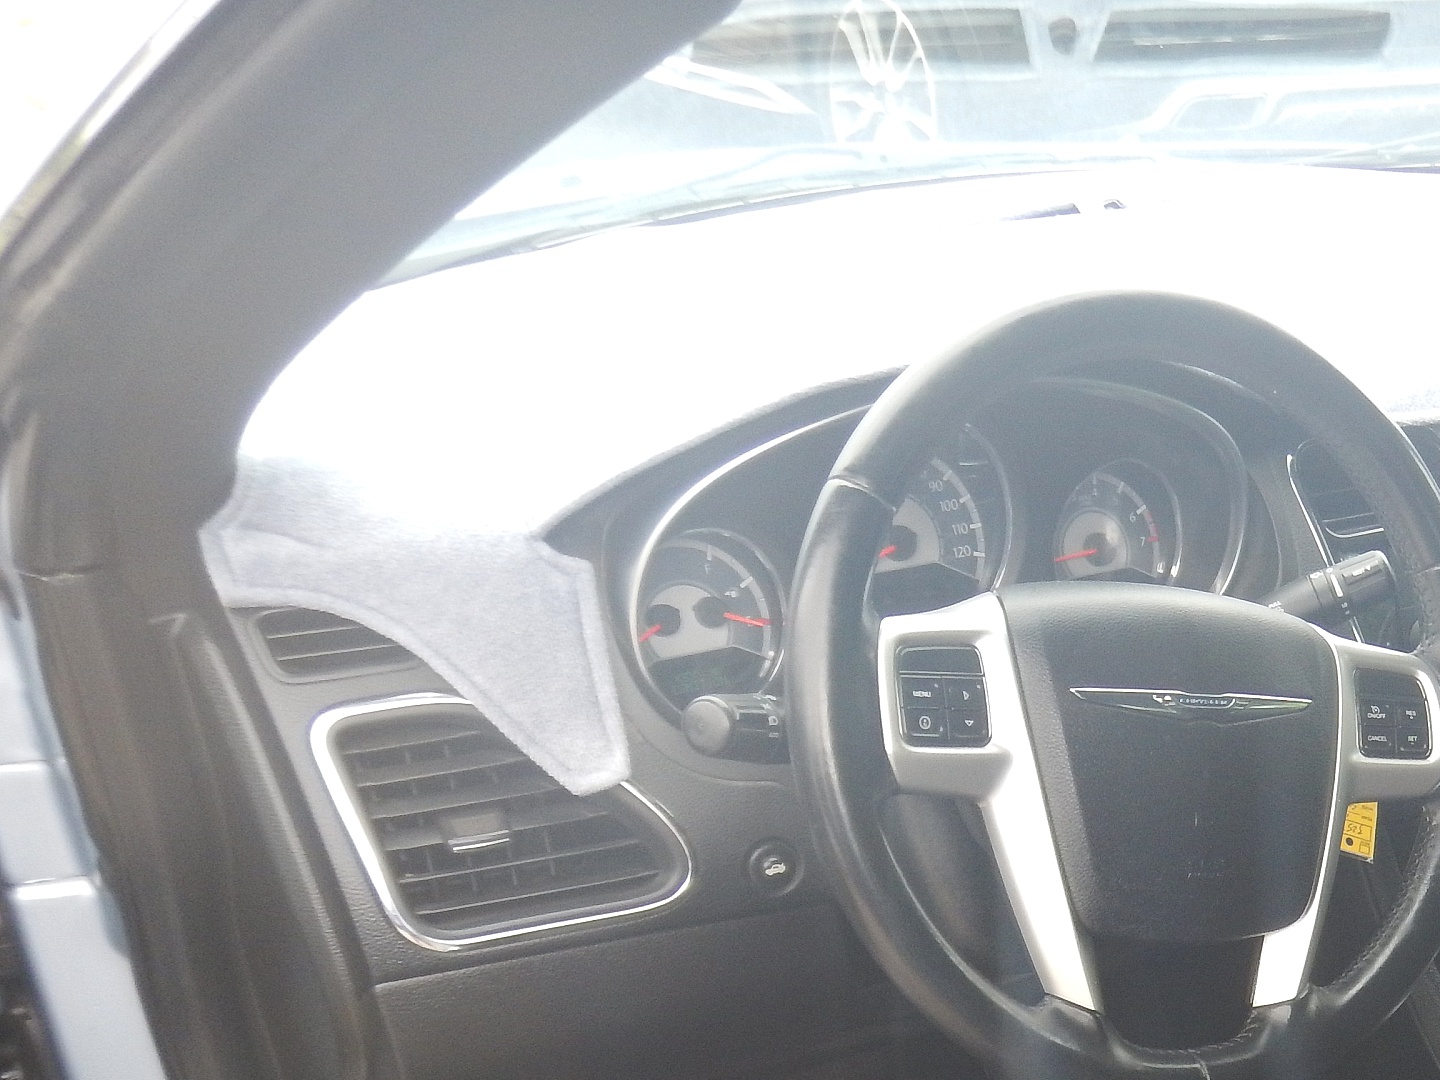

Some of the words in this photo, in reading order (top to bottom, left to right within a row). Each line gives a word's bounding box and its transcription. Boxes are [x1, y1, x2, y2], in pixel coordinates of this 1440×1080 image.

[928, 480, 943, 493] 90
[939, 498, 959, 512] 100
[1129, 512, 1136, 523] 6
[951, 522, 968, 536] 110
[1140, 536, 1146, 547] 7
[953, 545, 971, 558] 120
